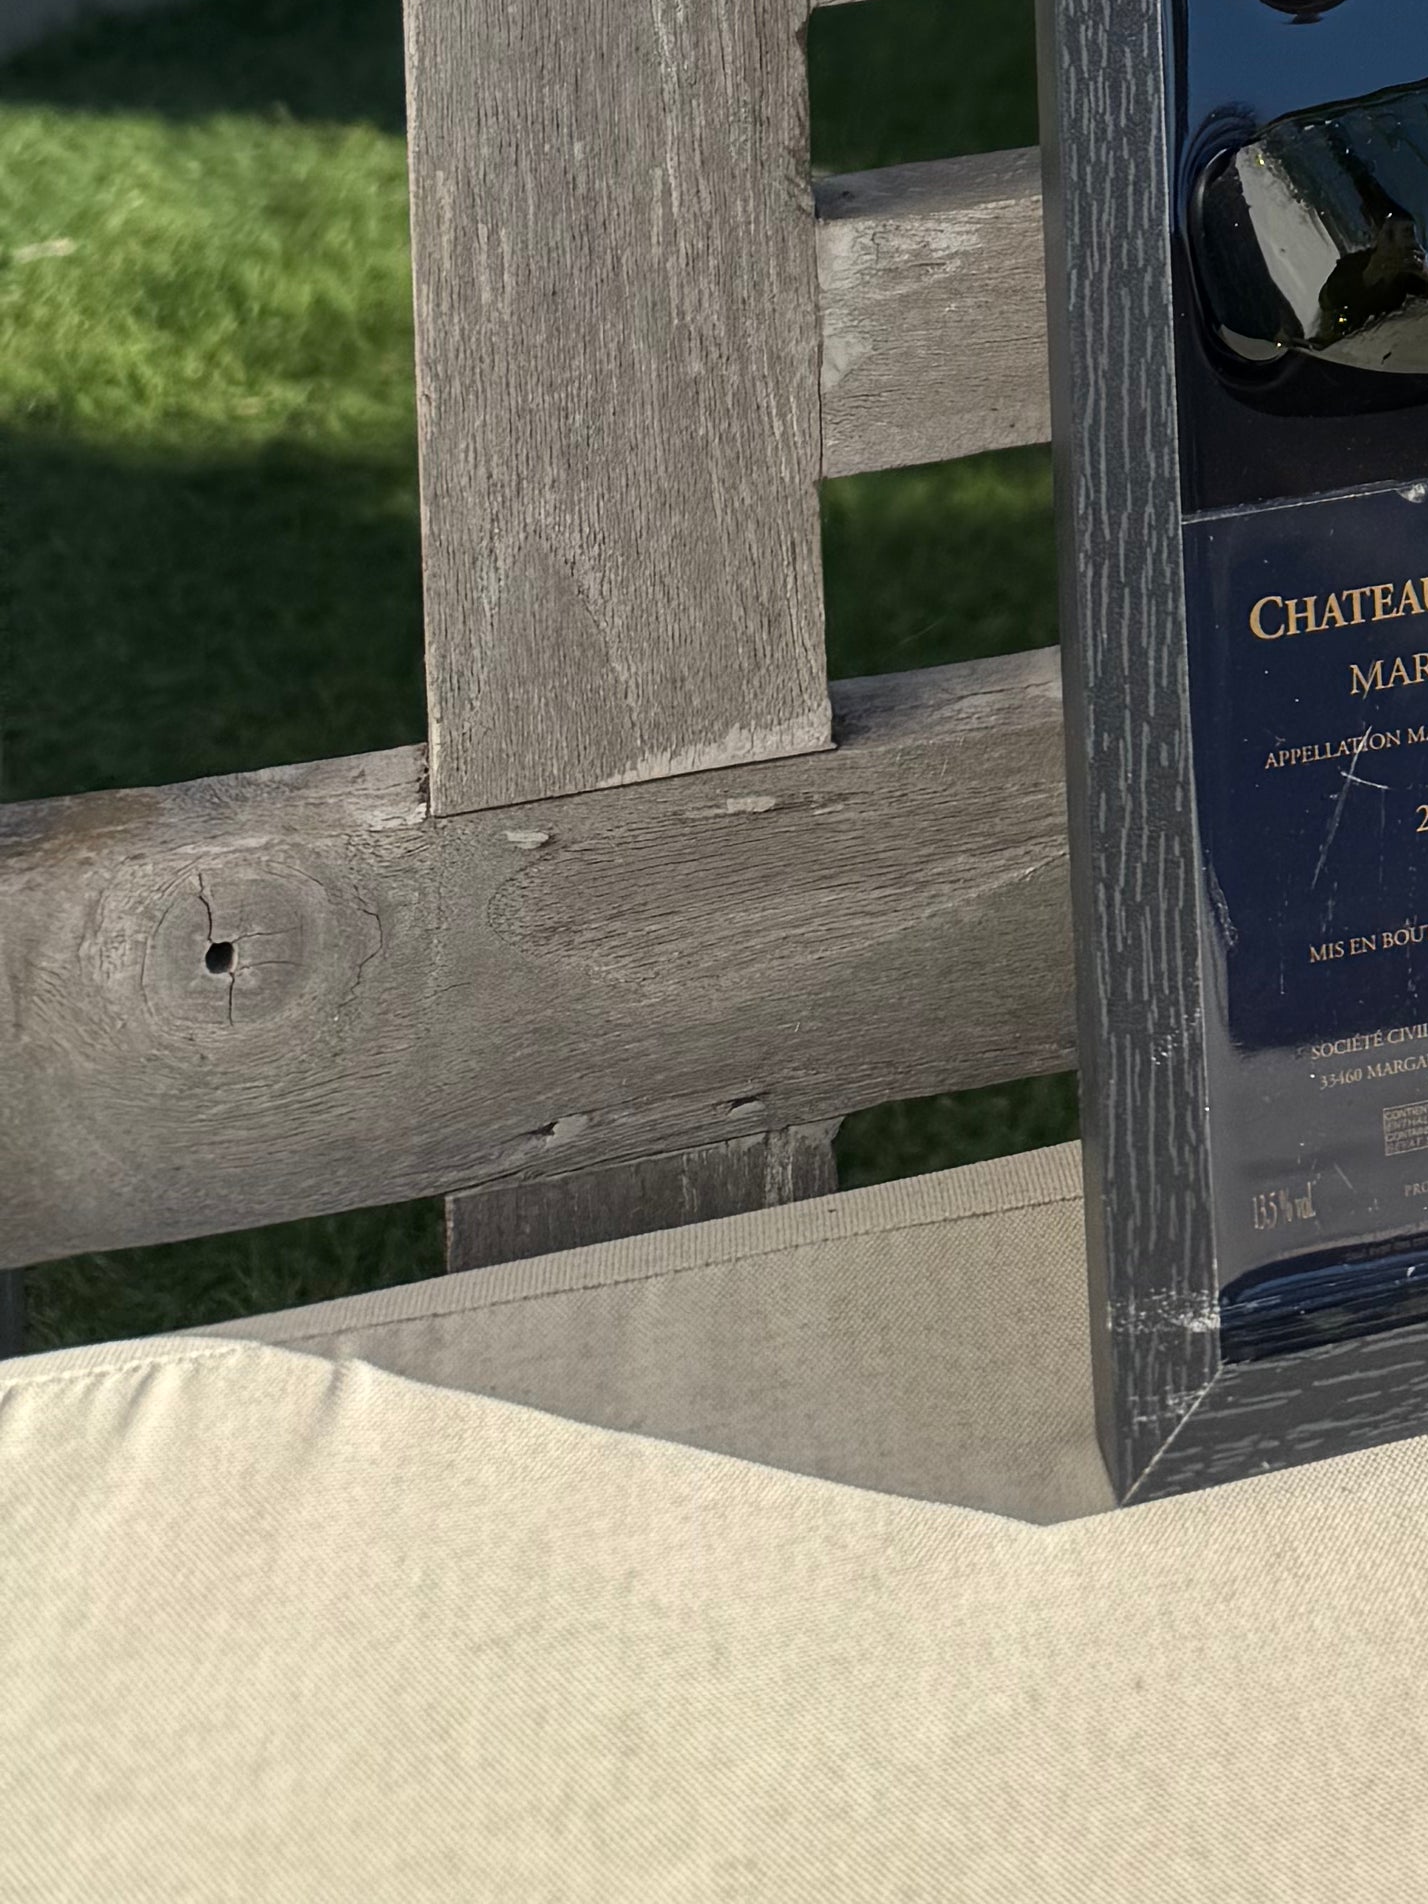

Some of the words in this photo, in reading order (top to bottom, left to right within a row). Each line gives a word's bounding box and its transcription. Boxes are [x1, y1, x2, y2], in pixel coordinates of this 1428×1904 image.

[1264, 729, 1400, 770] APPELLATION
[1308, 941, 1345, 964] MIS
[1350, 935, 1377, 956] EN
[1310, 1030, 1384, 1060] SOCIÉTÉ
[1319, 1068, 1363, 1090] 33460
